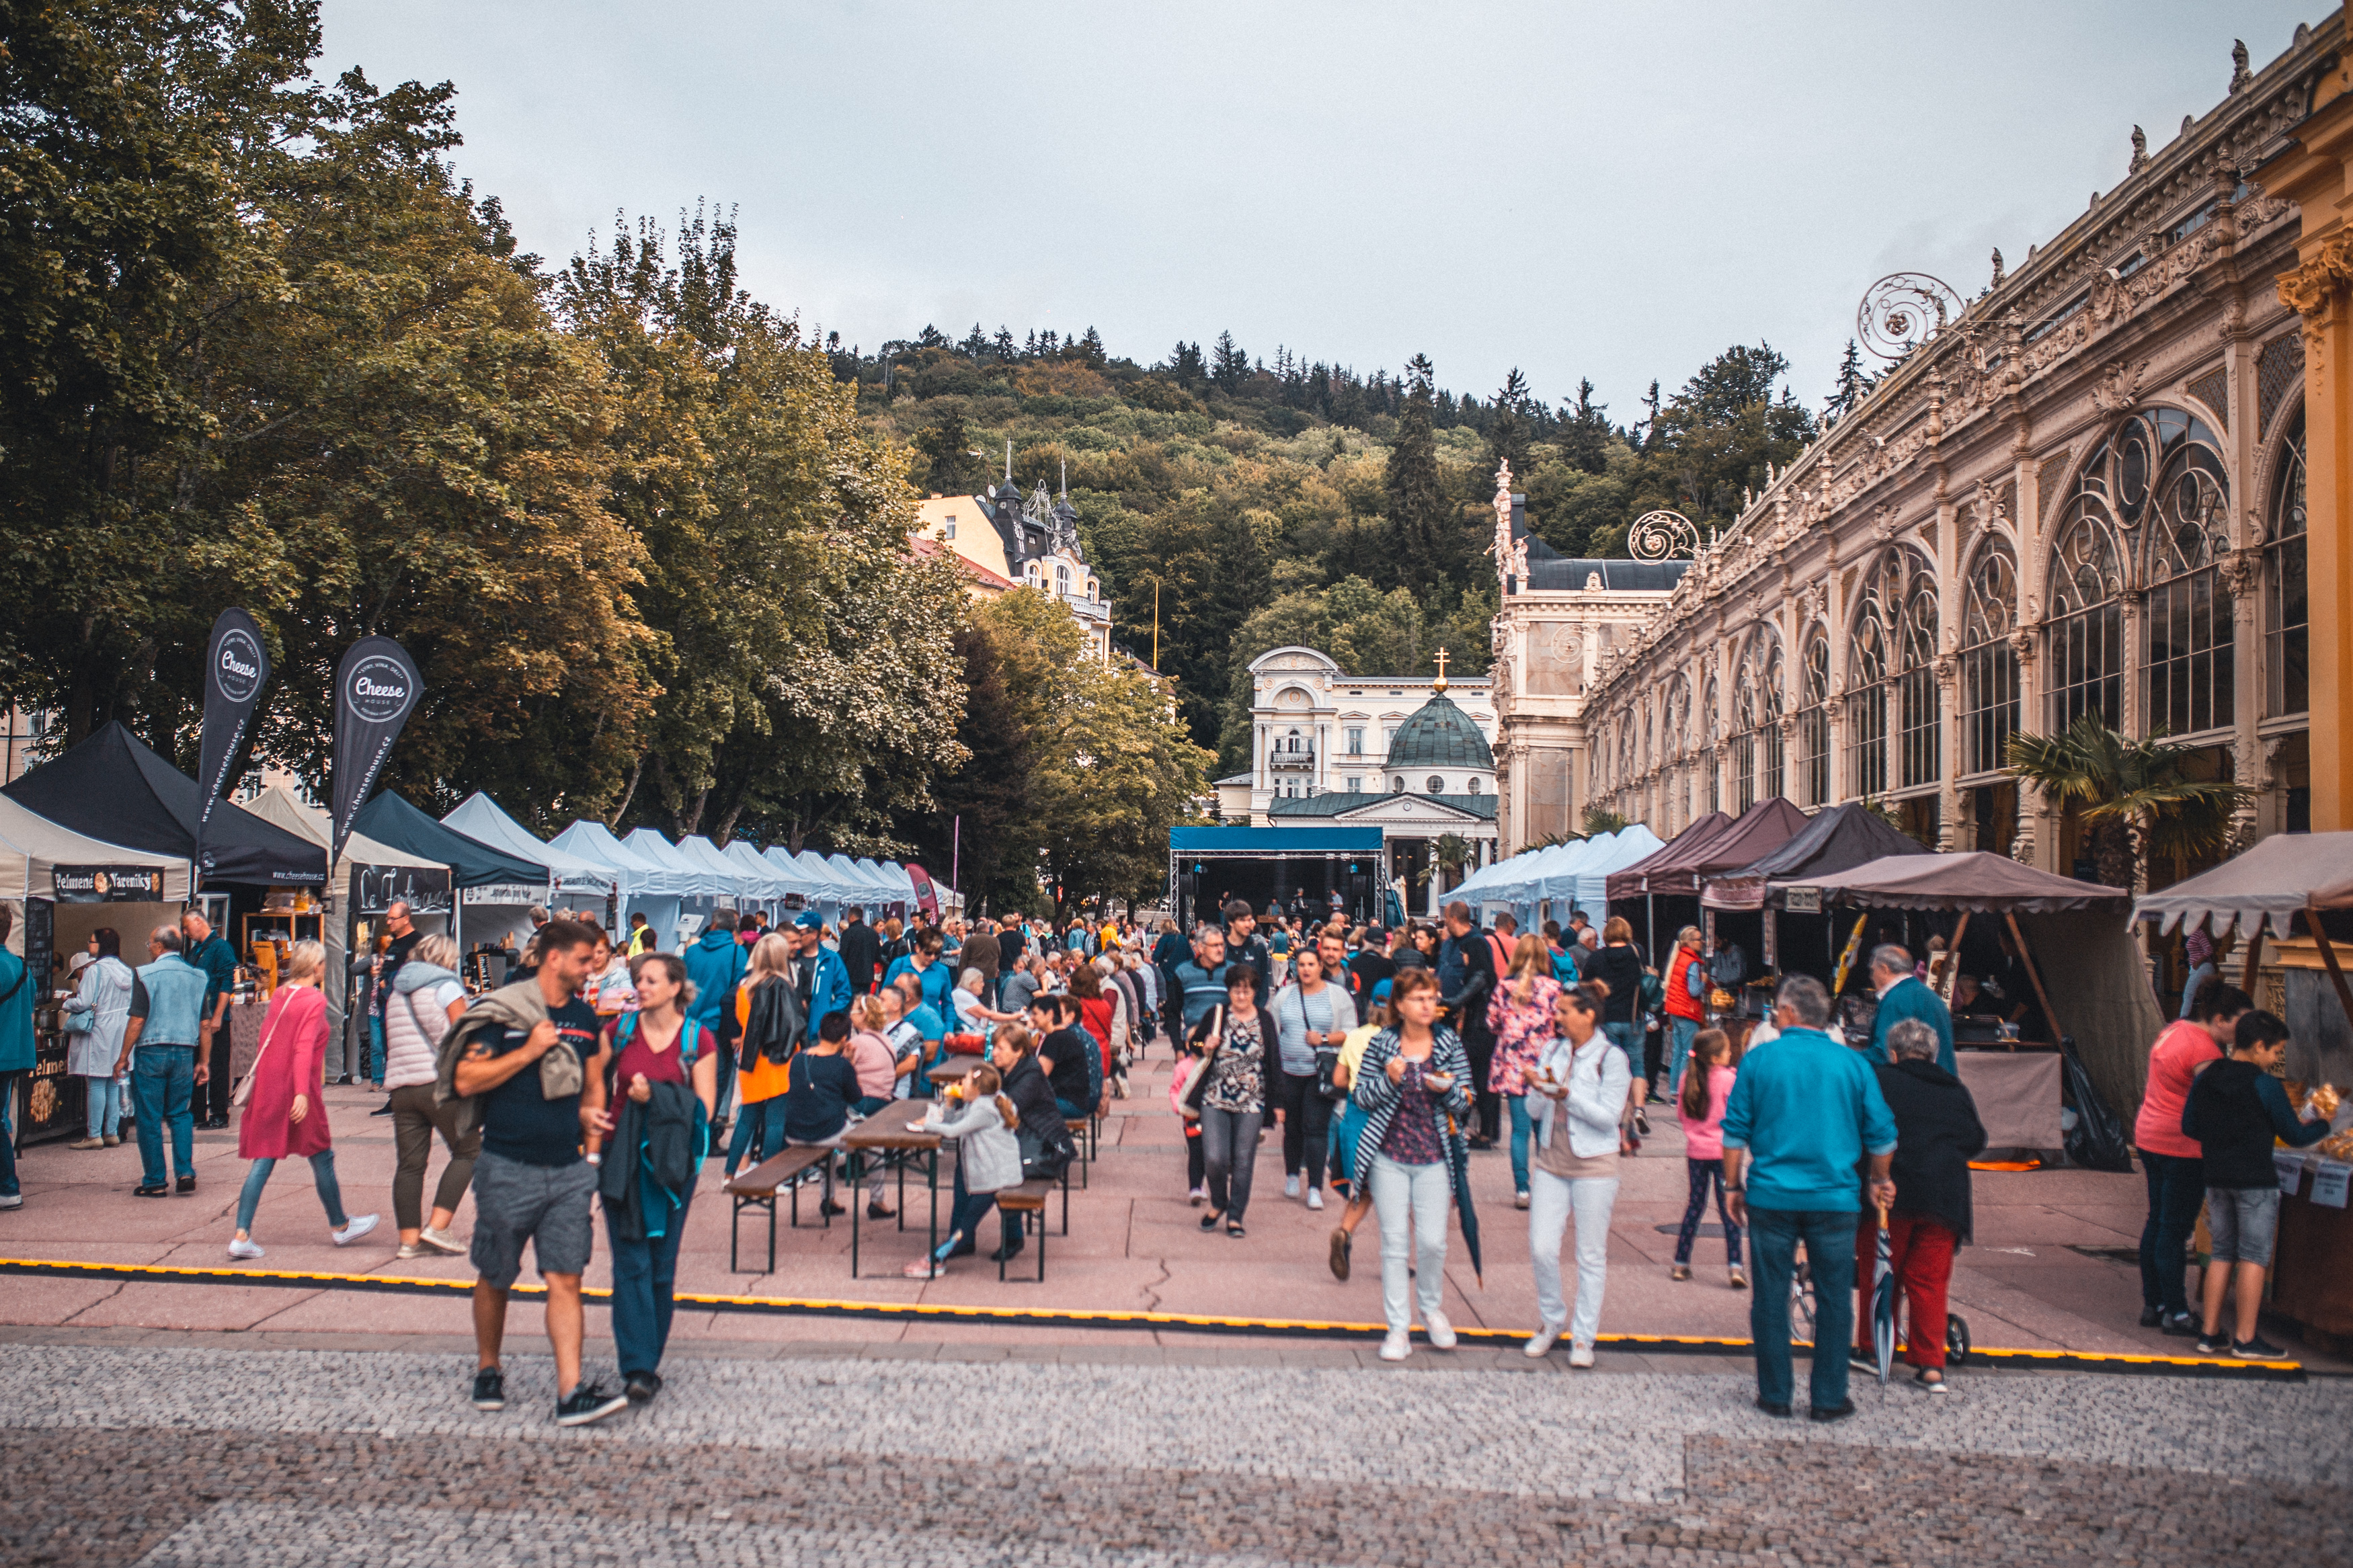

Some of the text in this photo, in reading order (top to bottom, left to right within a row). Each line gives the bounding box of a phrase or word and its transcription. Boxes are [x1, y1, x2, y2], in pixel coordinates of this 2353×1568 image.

[222, 651, 256, 678] Cheese
[227, 674, 246, 684] HOUSE
[356, 677, 405, 698] Cheese
[202, 718, 245, 822] www.cheesehouse.cz
[340, 736, 392, 837] www.cheesehouse.cz
[55, 872, 94, 889] Pelmené
[272, 870, 325, 880] www.cheesehouse.cz
